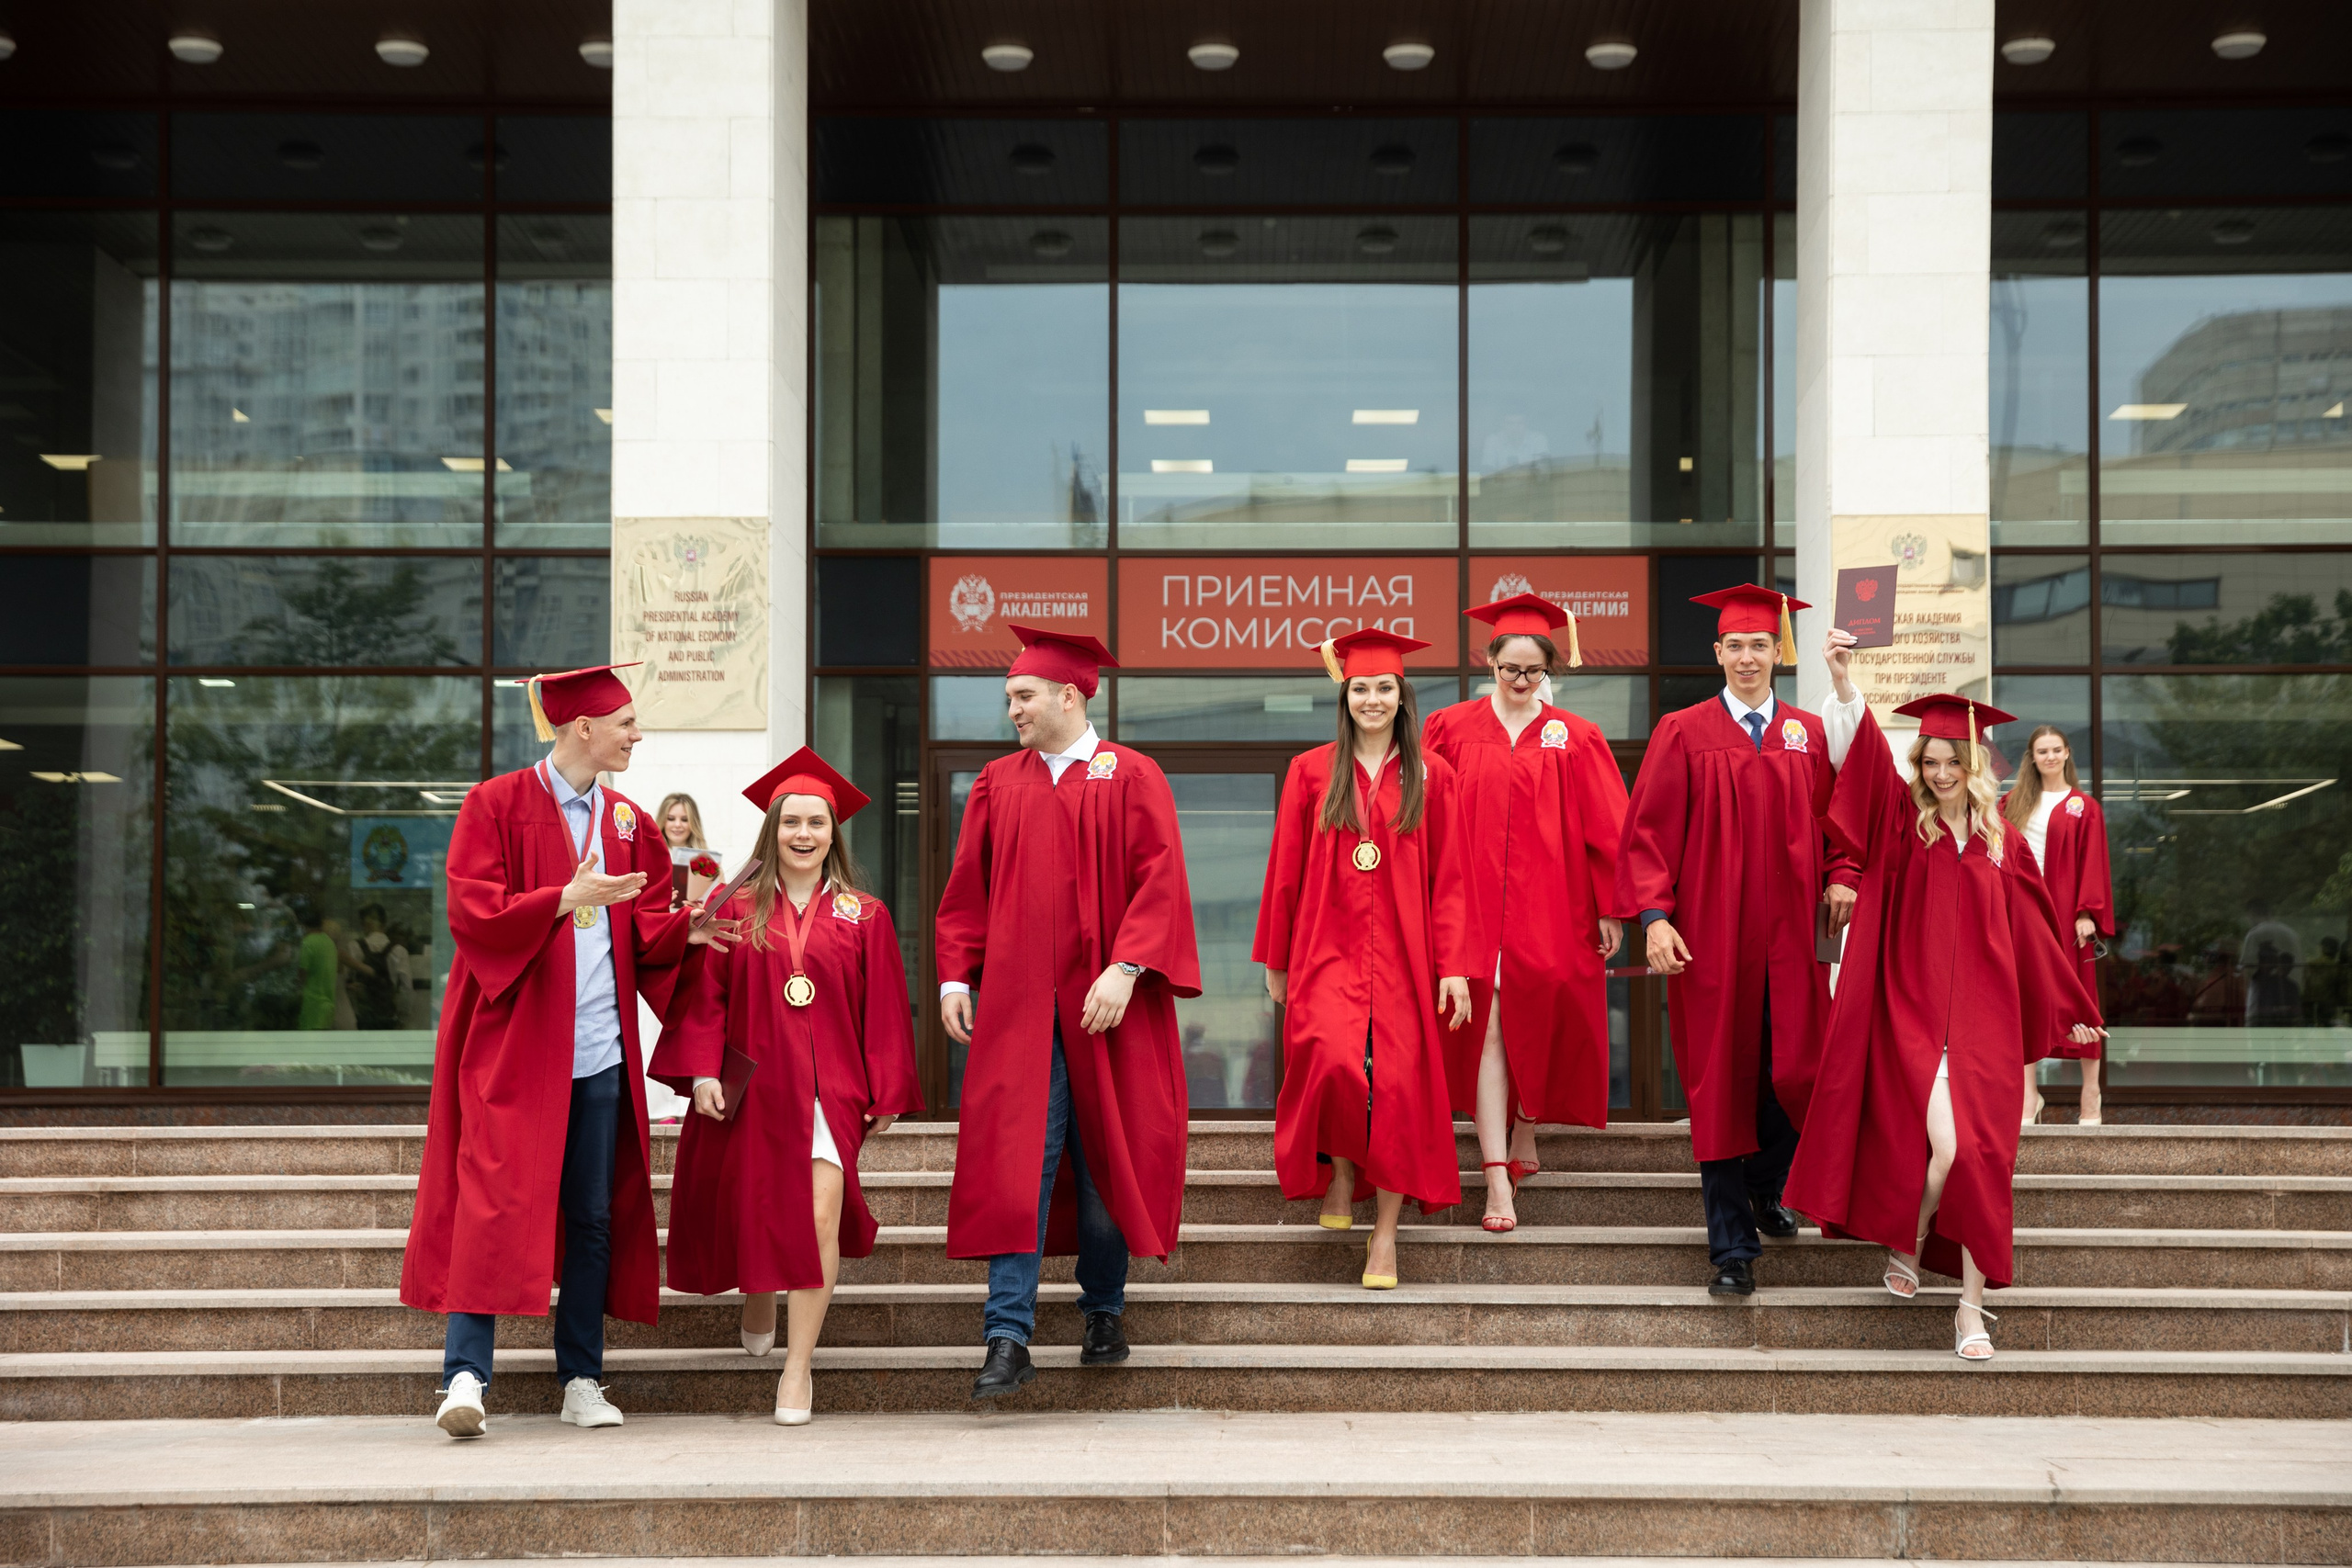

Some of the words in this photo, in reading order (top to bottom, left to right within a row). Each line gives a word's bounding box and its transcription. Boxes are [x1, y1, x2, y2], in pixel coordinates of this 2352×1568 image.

[674, 591, 708, 603] RUSSIAN
[1001, 592, 1089, 600] ПРЕЗИДЕНТСКАЯ
[1163, 575, 1413, 607] ПРИЕМНАЯ
[1001, 602, 1089, 616] АКАДЕМИЯ
[643, 611, 698, 622] PRESIDENTIAL
[701, 611, 740, 622] ACADEMY
[1848, 617, 1881, 626] ДИПЛОМ
[1916, 613, 1962, 625] АКАДЕМИЯ
[645, 630, 655, 642] OF
[658, 630, 695, 642] NATIONAL
[698, 630, 737, 642] ECONOMY
[1912, 630, 1962, 644] ХОЗЯЙСТВА
[668, 650, 684, 662] AND
[686, 650, 715, 662] PUBLIC
[1855, 651, 1935, 665] ГОСУДАРСТВЕННОЙ
[1937, 652, 1975, 664] СЛУЖБЫ
[658, 671, 725, 682] ADMINISTRATION
[1875, 672, 1892, 683] ПРИ
[1894, 671, 1947, 685] ПРЕЗИДЕНТЕ
[1865, 691, 1912, 704] ОССИЙСКОЙ
